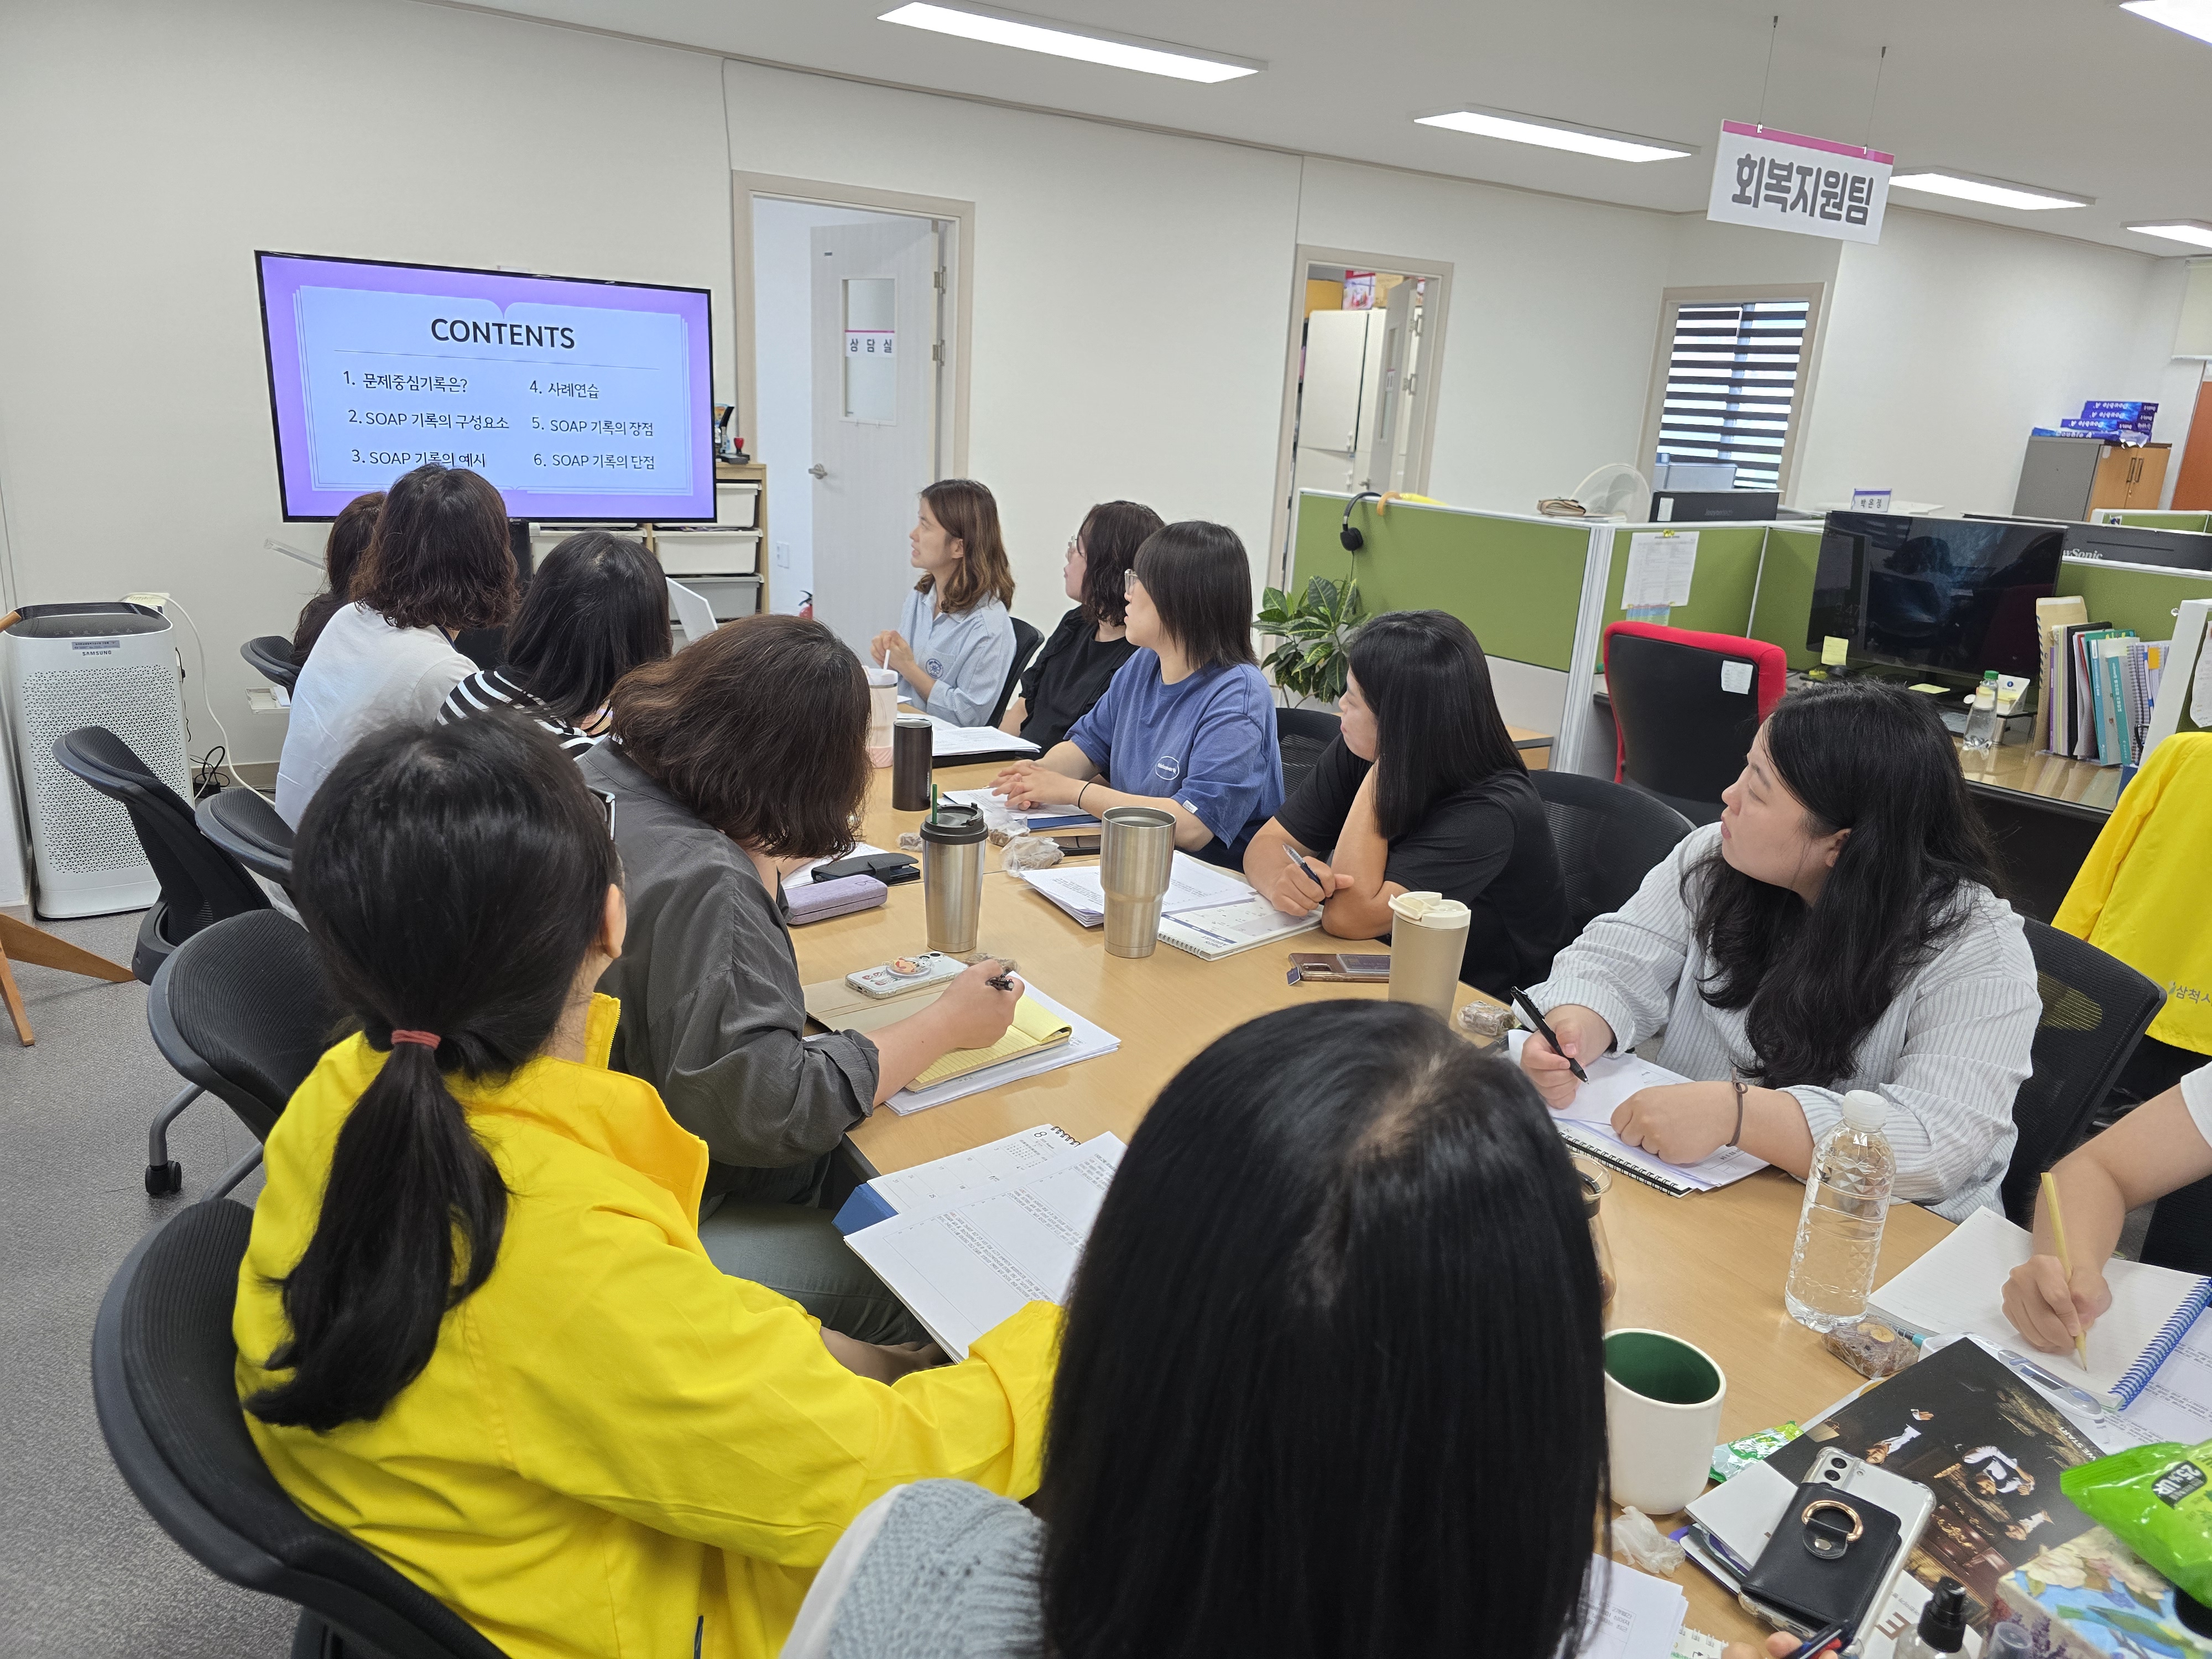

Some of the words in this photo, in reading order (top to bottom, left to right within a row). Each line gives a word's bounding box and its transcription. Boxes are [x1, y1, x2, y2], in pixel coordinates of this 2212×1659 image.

[1731, 153, 1874, 225] 회복지원팀
[431, 319, 575, 349] CONTENTS
[343, 371, 356, 385] 1.
[363, 373, 467, 392] 문제중심기록은?
[530, 380, 542, 394] 4.
[548, 383, 599, 399] 사례연습
[348, 409, 362, 424] 2.
[366, 412, 407, 425] SOAP
[412, 413, 451, 428] 기록의
[456, 415, 509, 430] 구성요소
[532, 417, 545, 430] 5.
[550, 420, 587, 432] SOAP
[591, 421, 626, 435] 기록의
[629, 422, 653, 436] 장점
[351, 449, 366, 463] 3.
[369, 452, 411, 465] SOAP
[415, 452, 455, 467] 기록의
[458, 453, 486, 467] 예시
[534, 454, 546, 467] 6.
[552, 455, 588, 466] SOAP
[593, 455, 628, 469] 기록의
[631, 456, 654, 469] 단점
[2063, 549, 2103, 560] wSonic
[2056, 1427, 2084, 1448] START
[2081, 1448, 2096, 1461] WE
